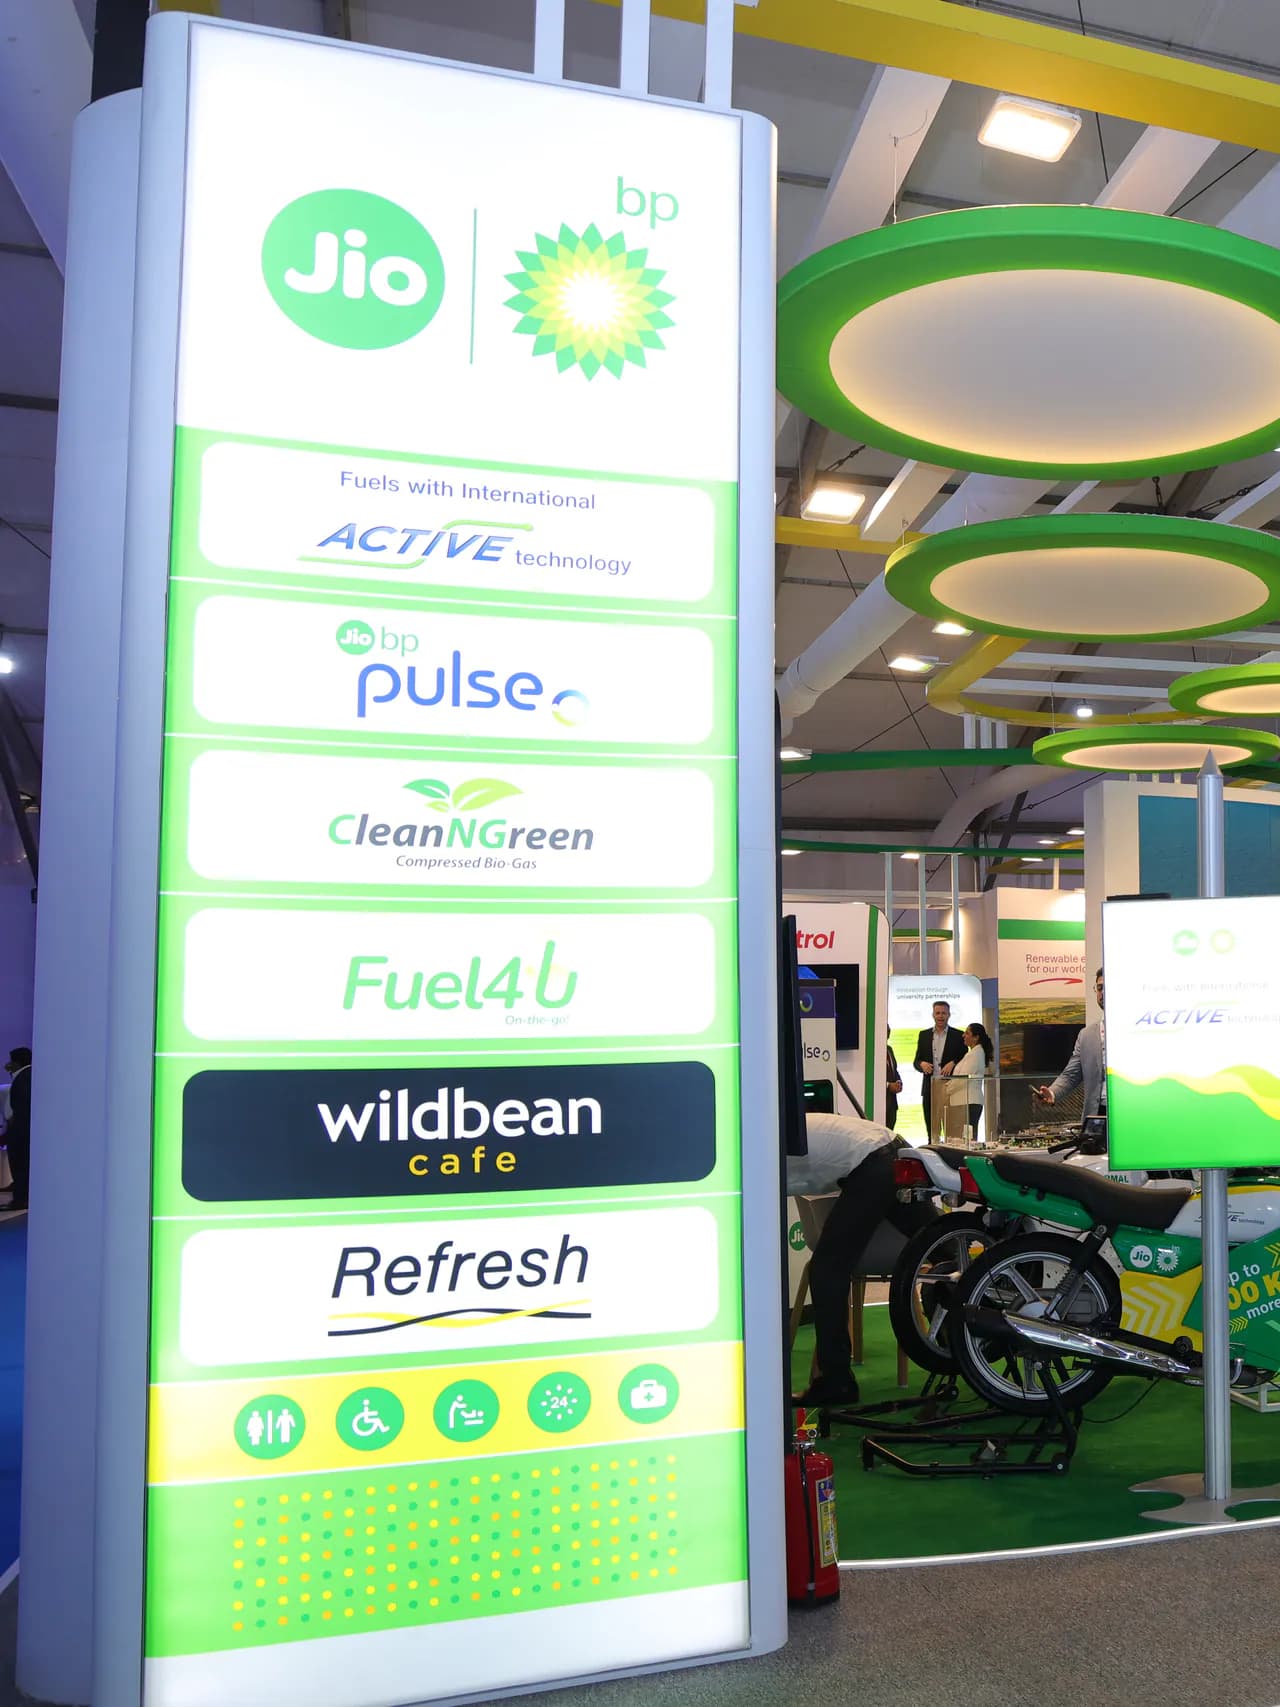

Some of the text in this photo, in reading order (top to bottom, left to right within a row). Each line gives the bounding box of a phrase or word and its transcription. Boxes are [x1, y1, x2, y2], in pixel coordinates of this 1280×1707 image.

[616, 175, 679, 229] bp
[284, 229, 428, 306] Jio
[340, 470, 597, 510] Fuels with International
[317, 522, 633, 575] ACTIVE technology
[340, 626, 420, 657] Jio bp
[357, 650, 544, 718] pulse
[327, 813, 595, 852] CleanNGreen
[395, 854, 538, 871] Compressed Bio-Gas
[796, 930, 836, 949] trol
[1025, 953, 1079, 963] Renewable
[1026, 963, 1040, 973] for
[1042, 965, 1059, 973] our
[1135, 1008, 1229, 1026] ACTIVE
[803, 1041, 821, 1059] lse
[318, 1087, 602, 1143] wildbean
[408, 1146, 517, 1175] cafe
[332, 1234, 590, 1299] Refresh
[1132, 1251, 1151, 1263] Jio
[1227, 1263, 1260, 1287] p to
[550, 1396, 569, 1409] 24
